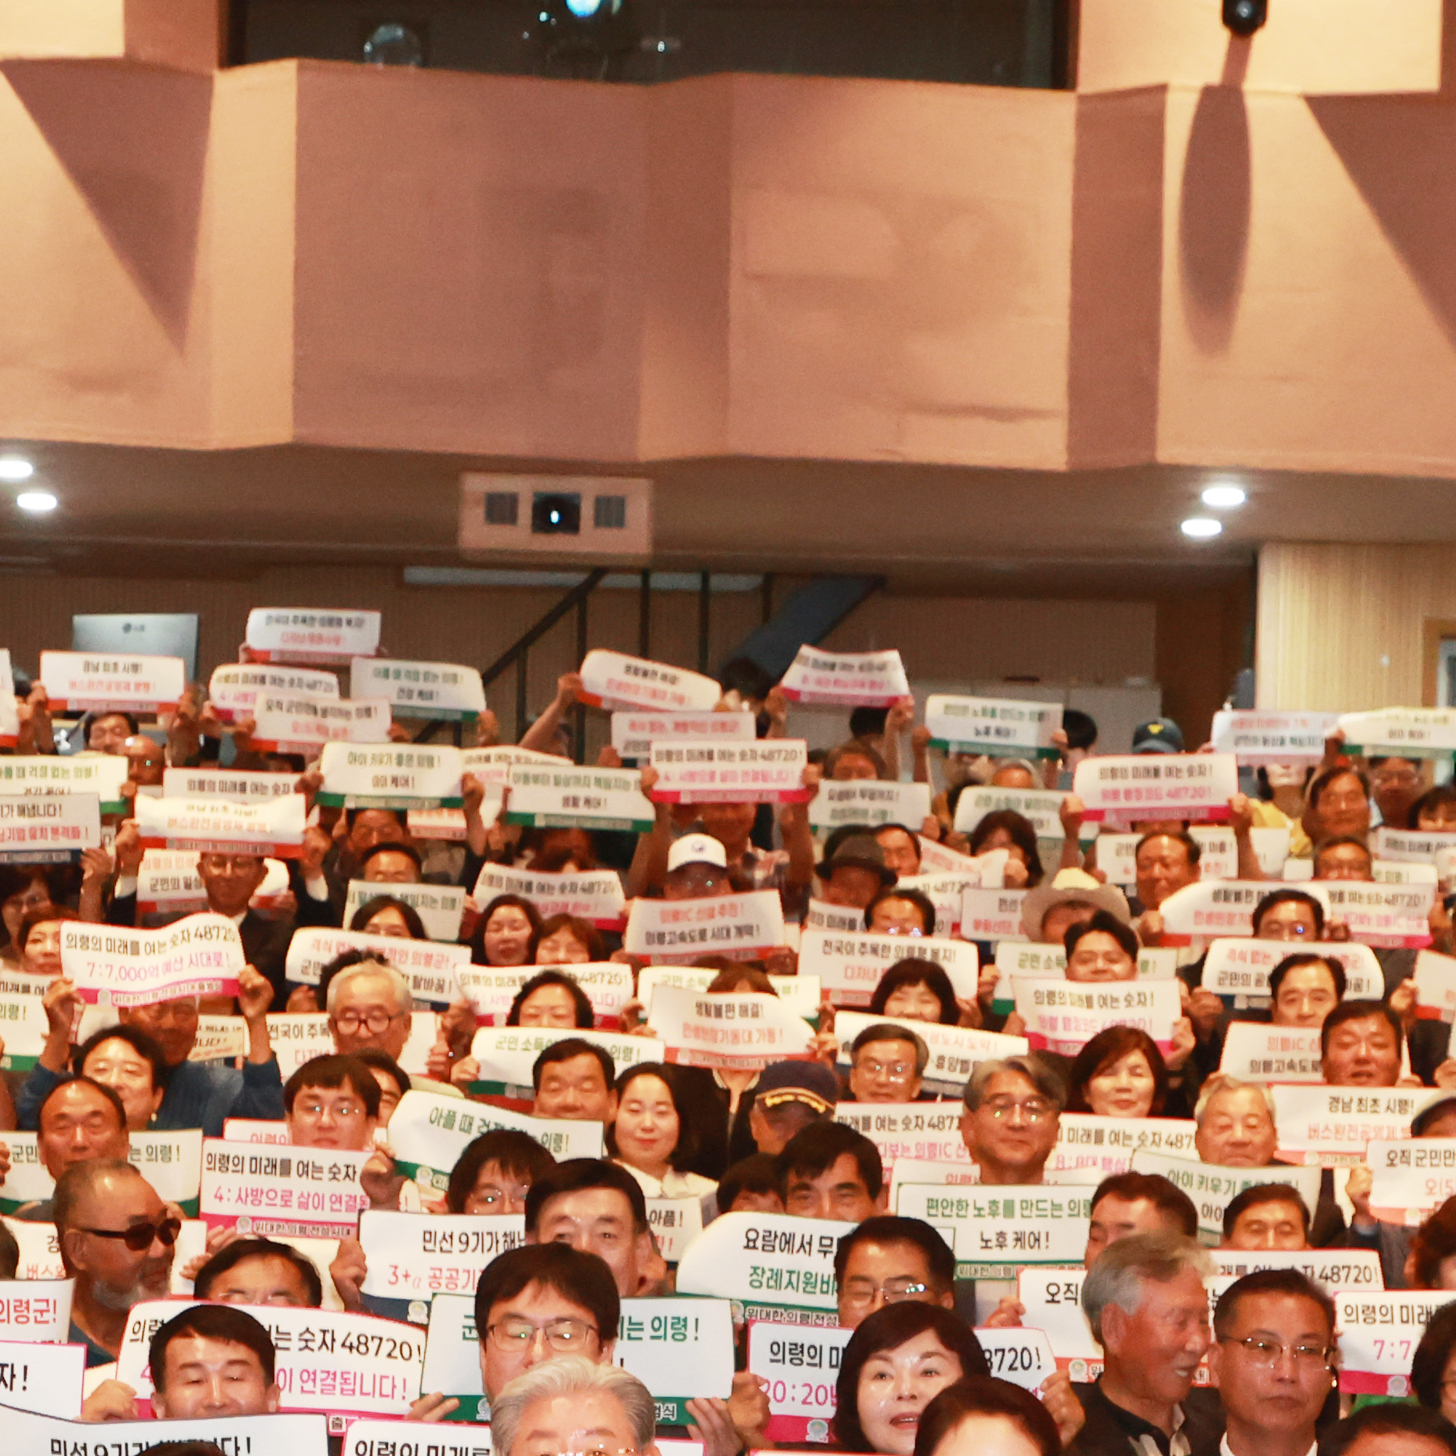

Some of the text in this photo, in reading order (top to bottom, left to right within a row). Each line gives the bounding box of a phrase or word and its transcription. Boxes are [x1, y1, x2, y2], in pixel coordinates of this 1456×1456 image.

[236, 1185, 294, 1209] 사방으로
[926, 1198, 1015, 1219] 편안한 노후를
[743, 1228, 812, 1254] 요람에서
[297, 1325, 336, 1354] 숫자
